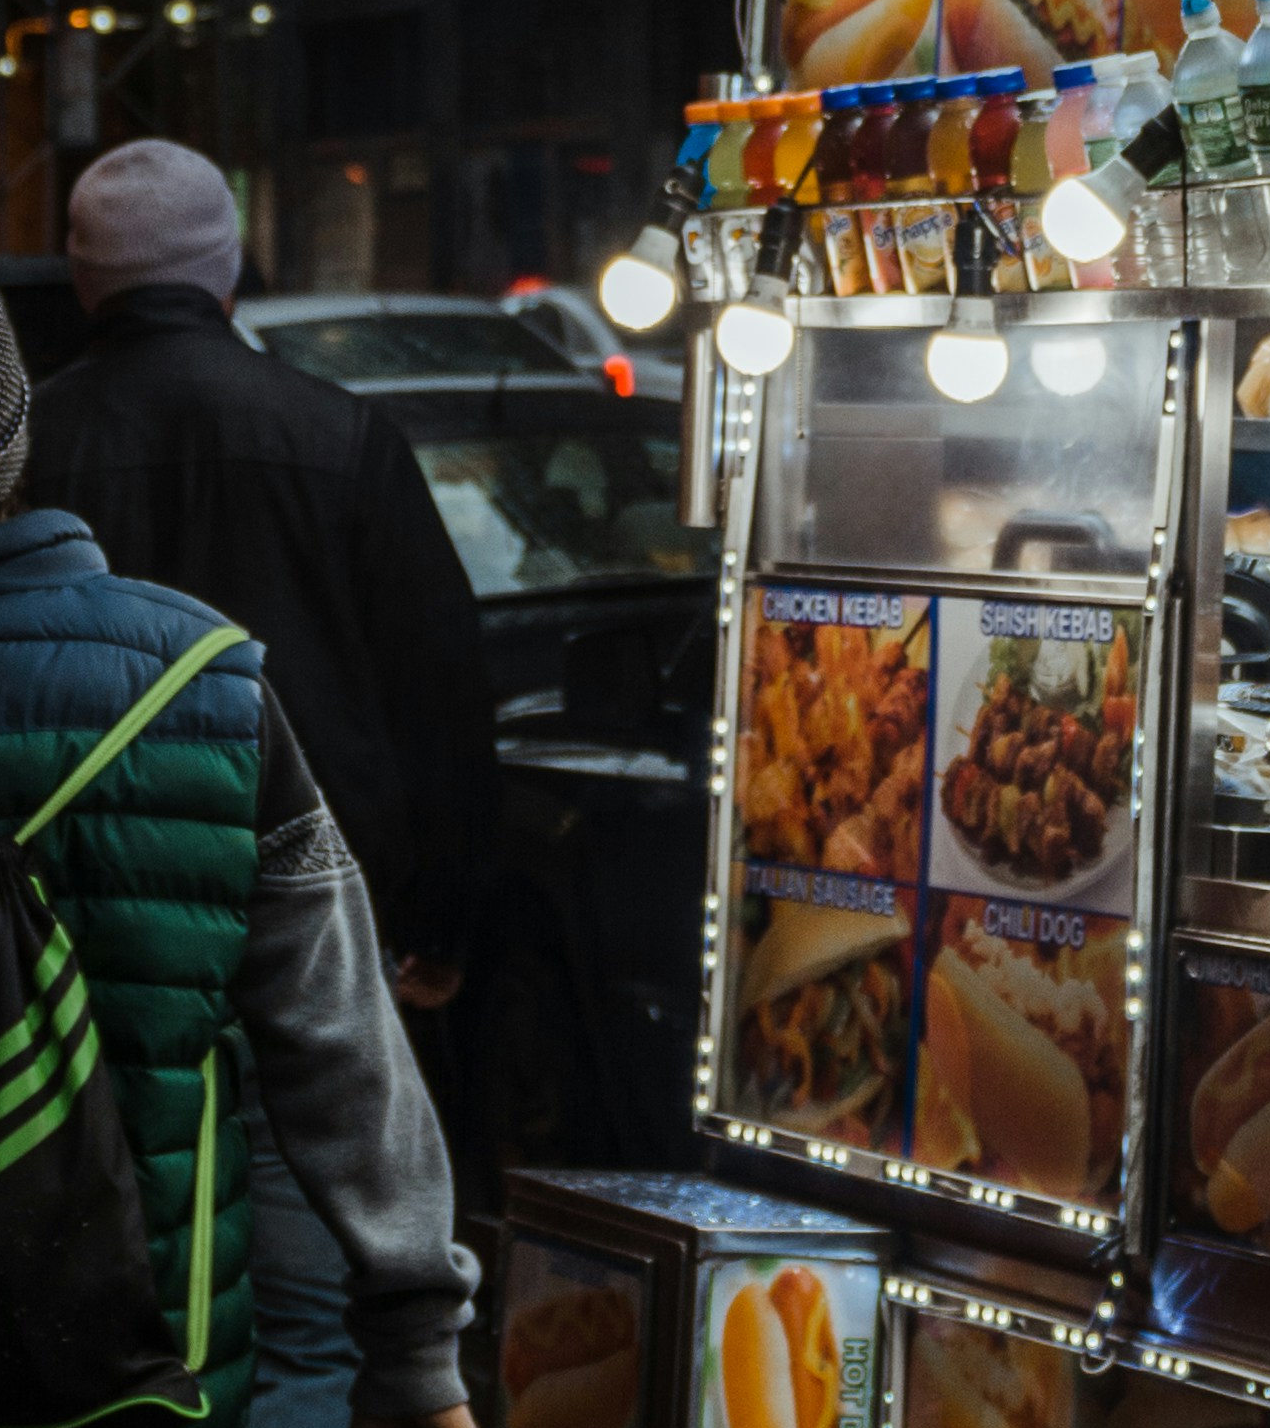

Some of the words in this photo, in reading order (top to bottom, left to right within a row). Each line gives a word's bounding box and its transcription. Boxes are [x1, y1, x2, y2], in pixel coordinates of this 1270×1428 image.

[763, 589, 839, 625] CHICKEN
[843, 594, 903, 628] KEBAB
[980, 601, 1040, 638] SHISH
[1044, 606, 1114, 642] KEBAB
[813, 871, 896, 916] SAUSAGE
[983, 900, 1032, 940] CHILI
[1039, 908, 1085, 947] DOG
[842, 1338, 870, 1408] HOT
